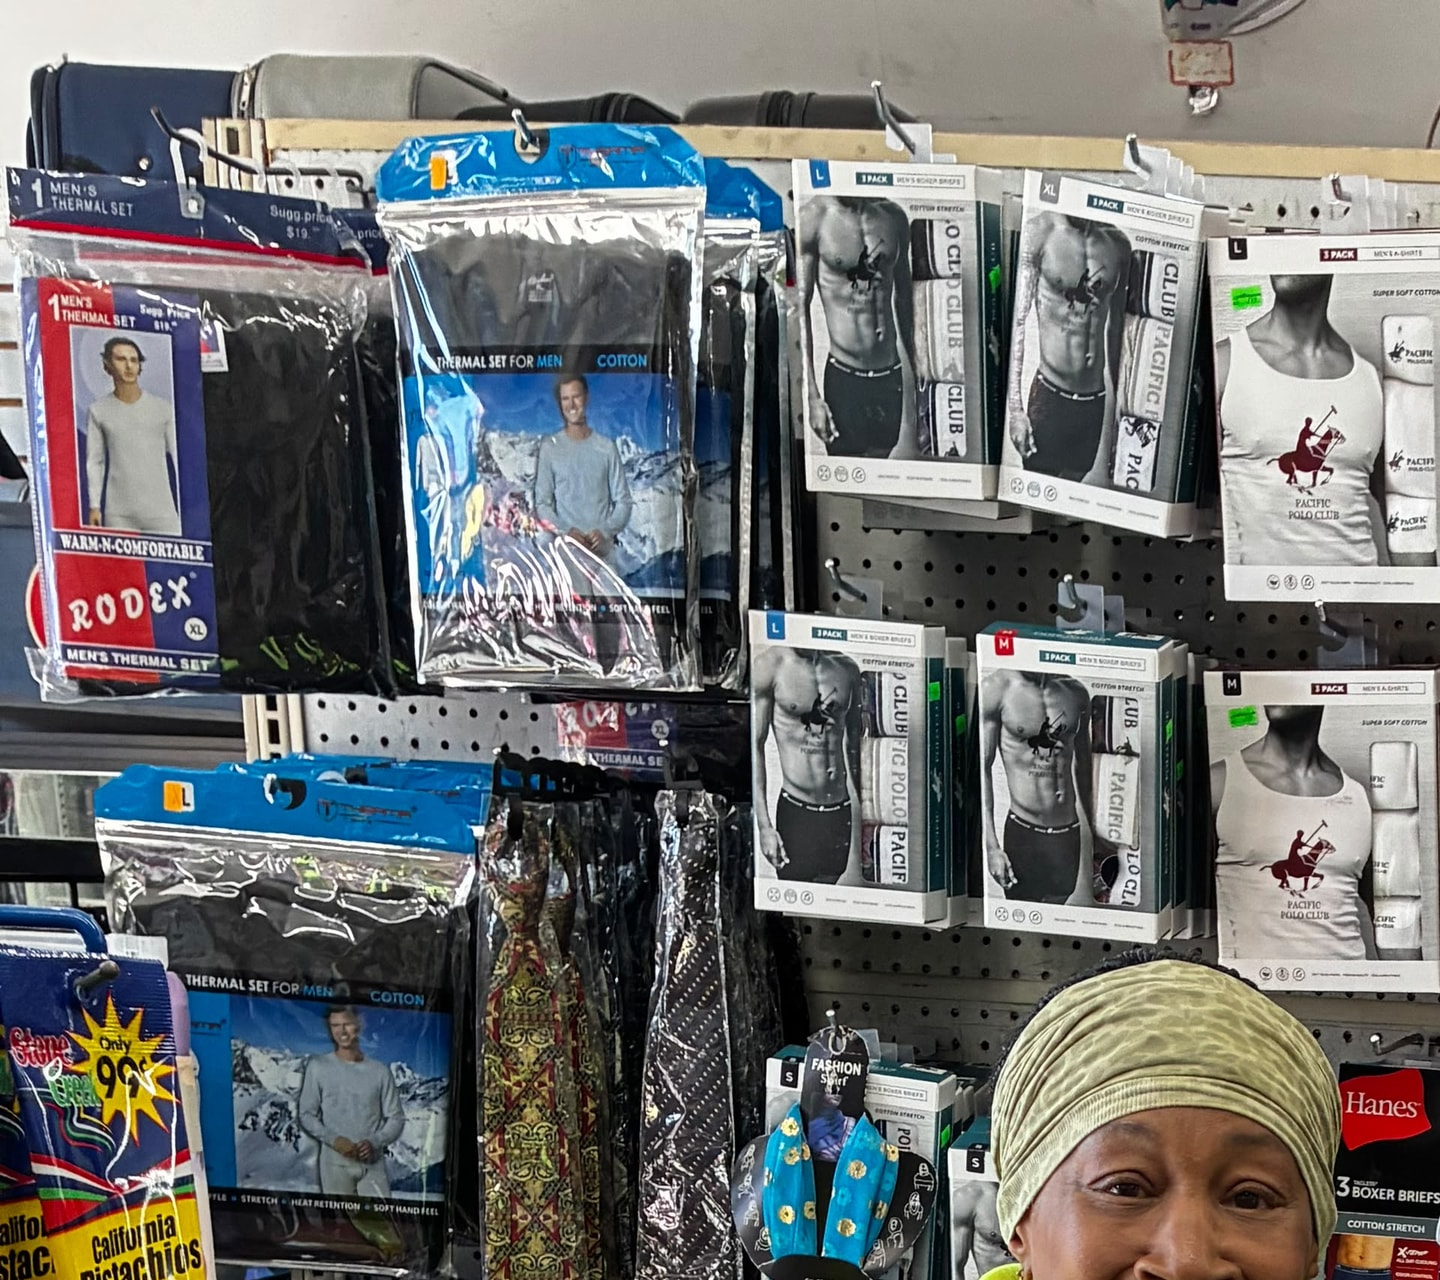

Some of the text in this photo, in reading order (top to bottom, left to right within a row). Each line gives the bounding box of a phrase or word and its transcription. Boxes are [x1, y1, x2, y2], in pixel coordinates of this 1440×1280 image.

[815, 168, 824, 180] L
[50, 181, 97, 197] MEN'S
[1043, 183, 1056, 197] XL
[51, 196, 134, 217] THERMAL SET
[1234, 241, 1242, 253] L
[1330, 250, 1354, 260] PACK
[1161, 262, 1179, 317] CLUB
[61, 294, 92, 309] MEN'S
[61, 309, 136, 329] THERMAL SET
[437, 354, 647, 369] THERMAL SET FOR MEN COTTON
[946, 384, 965, 435] CLUB
[1295, 498, 1331, 509] PACIFIC
[1288, 510, 1340, 521] POLO CLUB
[68, 576, 192, 633] RODEX
[189, 624, 203, 636] XL
[771, 622, 779, 633] L
[823, 630, 843, 639] PACK
[1000, 640, 1009, 650] M
[66, 648, 210, 671] MEN'S THERMAL SET
[1050, 654, 1070, 662] PACK
[1227, 678, 1237, 689] M
[1321, 684, 1345, 694] PACK
[596, 754, 646, 766] THERMAL
[1107, 771, 1127, 842] PACIFIC
[1287, 900, 1322, 911] PACIFIC
[1280, 910, 1330, 921] POLO CLUB
[186, 973, 424, 1006] THERMAL SET FOR MEN COTTON
[100, 1036, 132, 1056] Only
[811, 1058, 861, 1077] FASHION
[785, 1070, 794, 1083] S
[1346, 1091, 1418, 1118] Hanes
[972, 1157, 980, 1168] S
[1336, 1176, 1350, 1197] 3
[1352, 1187, 1440, 1204] BOXER BRIEFS
[241, 1195, 394, 1212] STRETCH HEAT RETENTION SOFT
[1347, 1220, 1425, 1233] COTTON STRETCH
[92, 1213, 177, 1265] California
